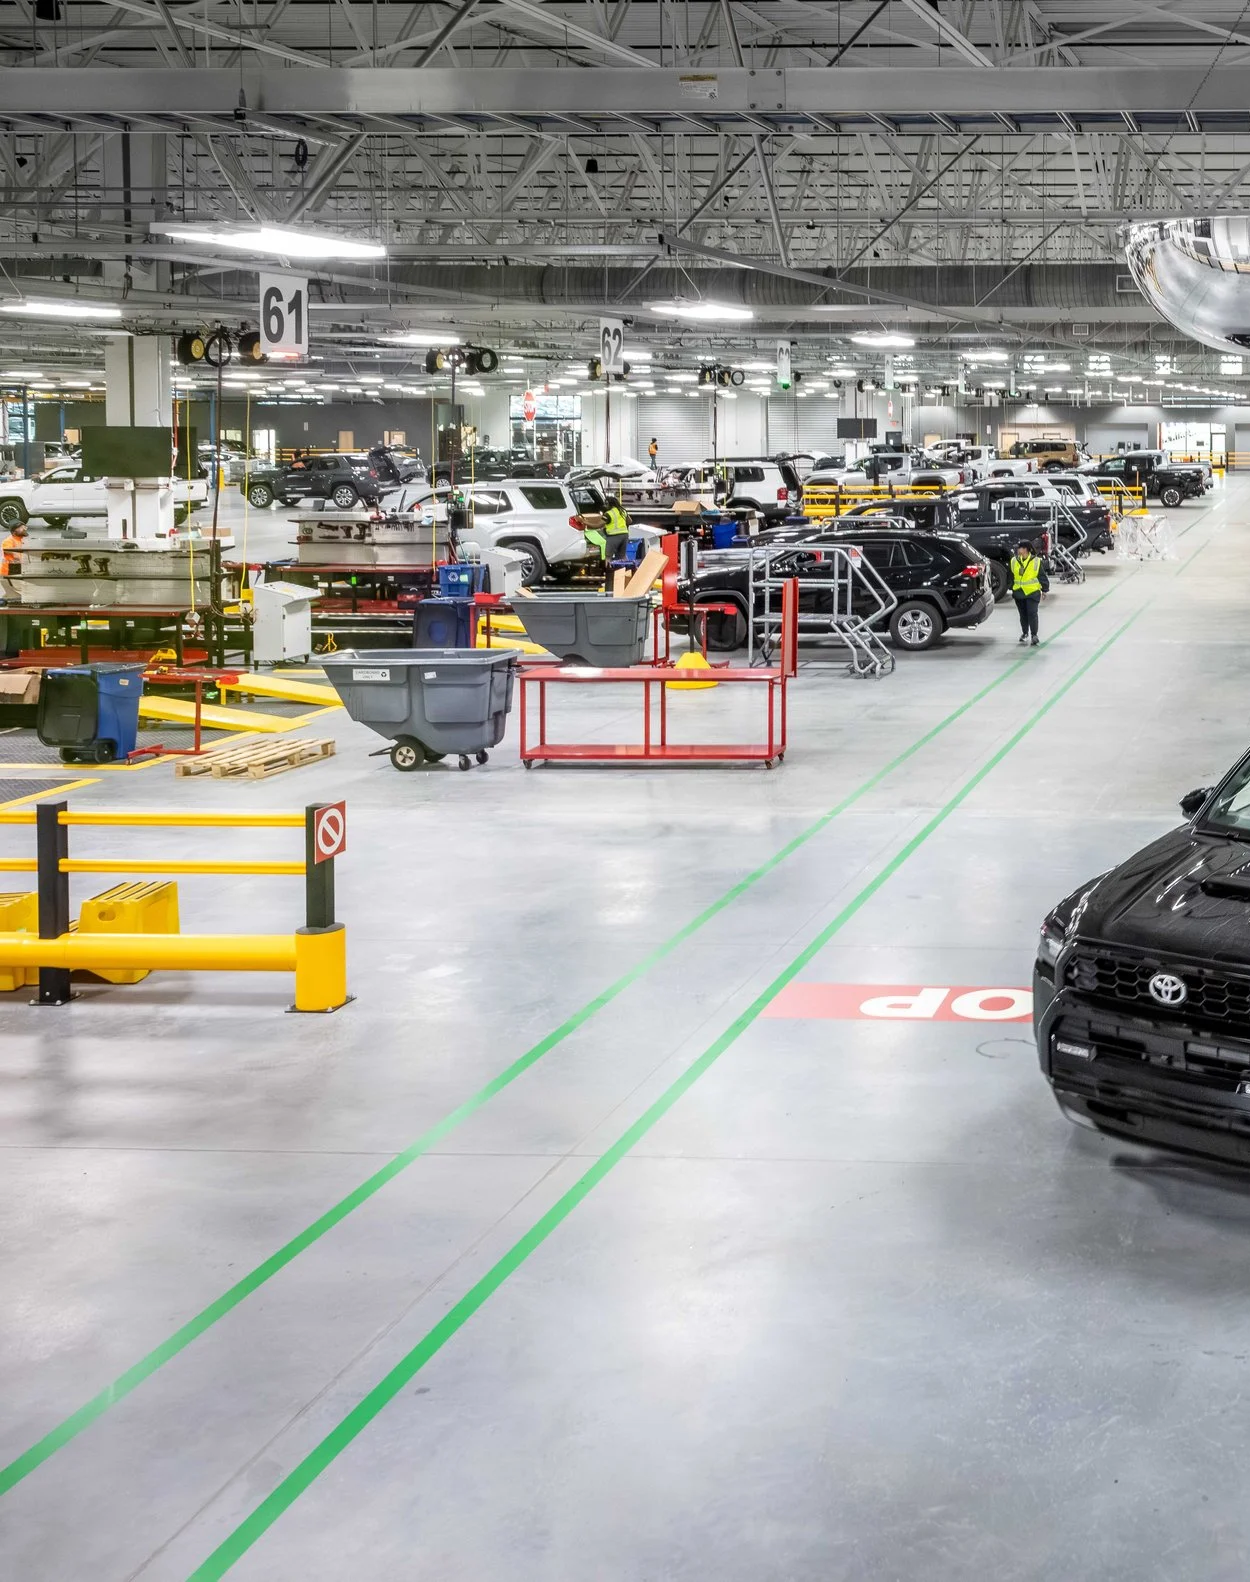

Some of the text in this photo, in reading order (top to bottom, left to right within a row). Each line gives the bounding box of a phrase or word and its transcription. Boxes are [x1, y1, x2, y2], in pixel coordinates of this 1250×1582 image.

[263, 287, 302, 344] 61
[602, 327, 622, 365] 62
[859, 988, 1033, 1019] OP
